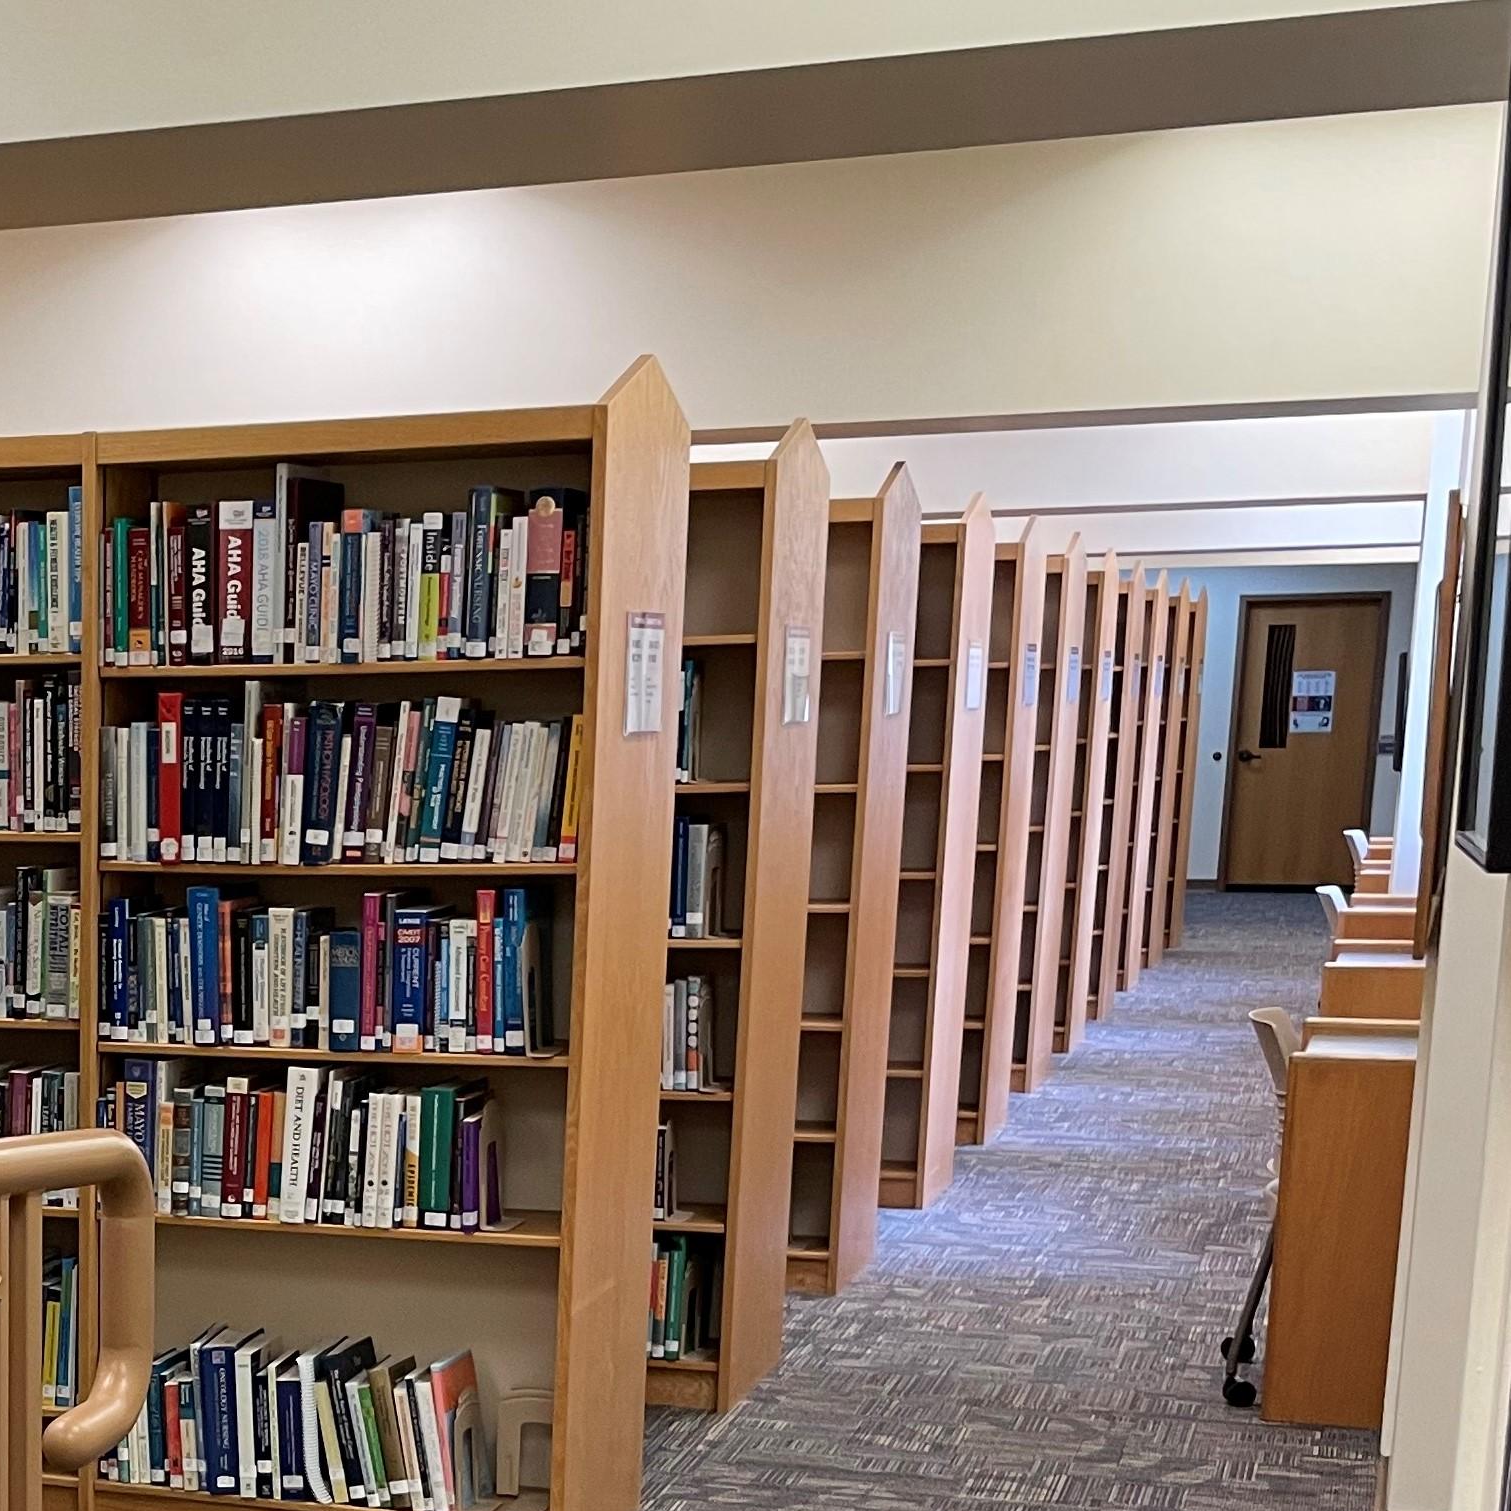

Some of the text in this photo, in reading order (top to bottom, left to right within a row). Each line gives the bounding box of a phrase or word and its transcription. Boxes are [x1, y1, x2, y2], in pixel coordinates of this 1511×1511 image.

[256, 529, 270, 592] 2018 AHA
[298, 546, 306, 595] BELLEVUE
[425, 531, 438, 571] Inside
[473, 524, 487, 624] FORENSIC NURSING
[192, 547, 206, 625] AHA Guid
[226, 535, 242, 620] AHA Guid
[308, 561, 319, 632] MAYO CLINIC
[222, 646, 244, 656] 2016
[49, 904, 58, 952] NUTRITION
[58, 904, 69, 952] TOTAL
[397, 935, 421, 944] 2007
[412, 947, 420, 988] CURRENT
[133, 1103, 145, 1142] MAYO
[289, 1086, 304, 1187] DIET AND HEALTH
[219, 1367, 230, 1449] ONCOLOGY NURSING
